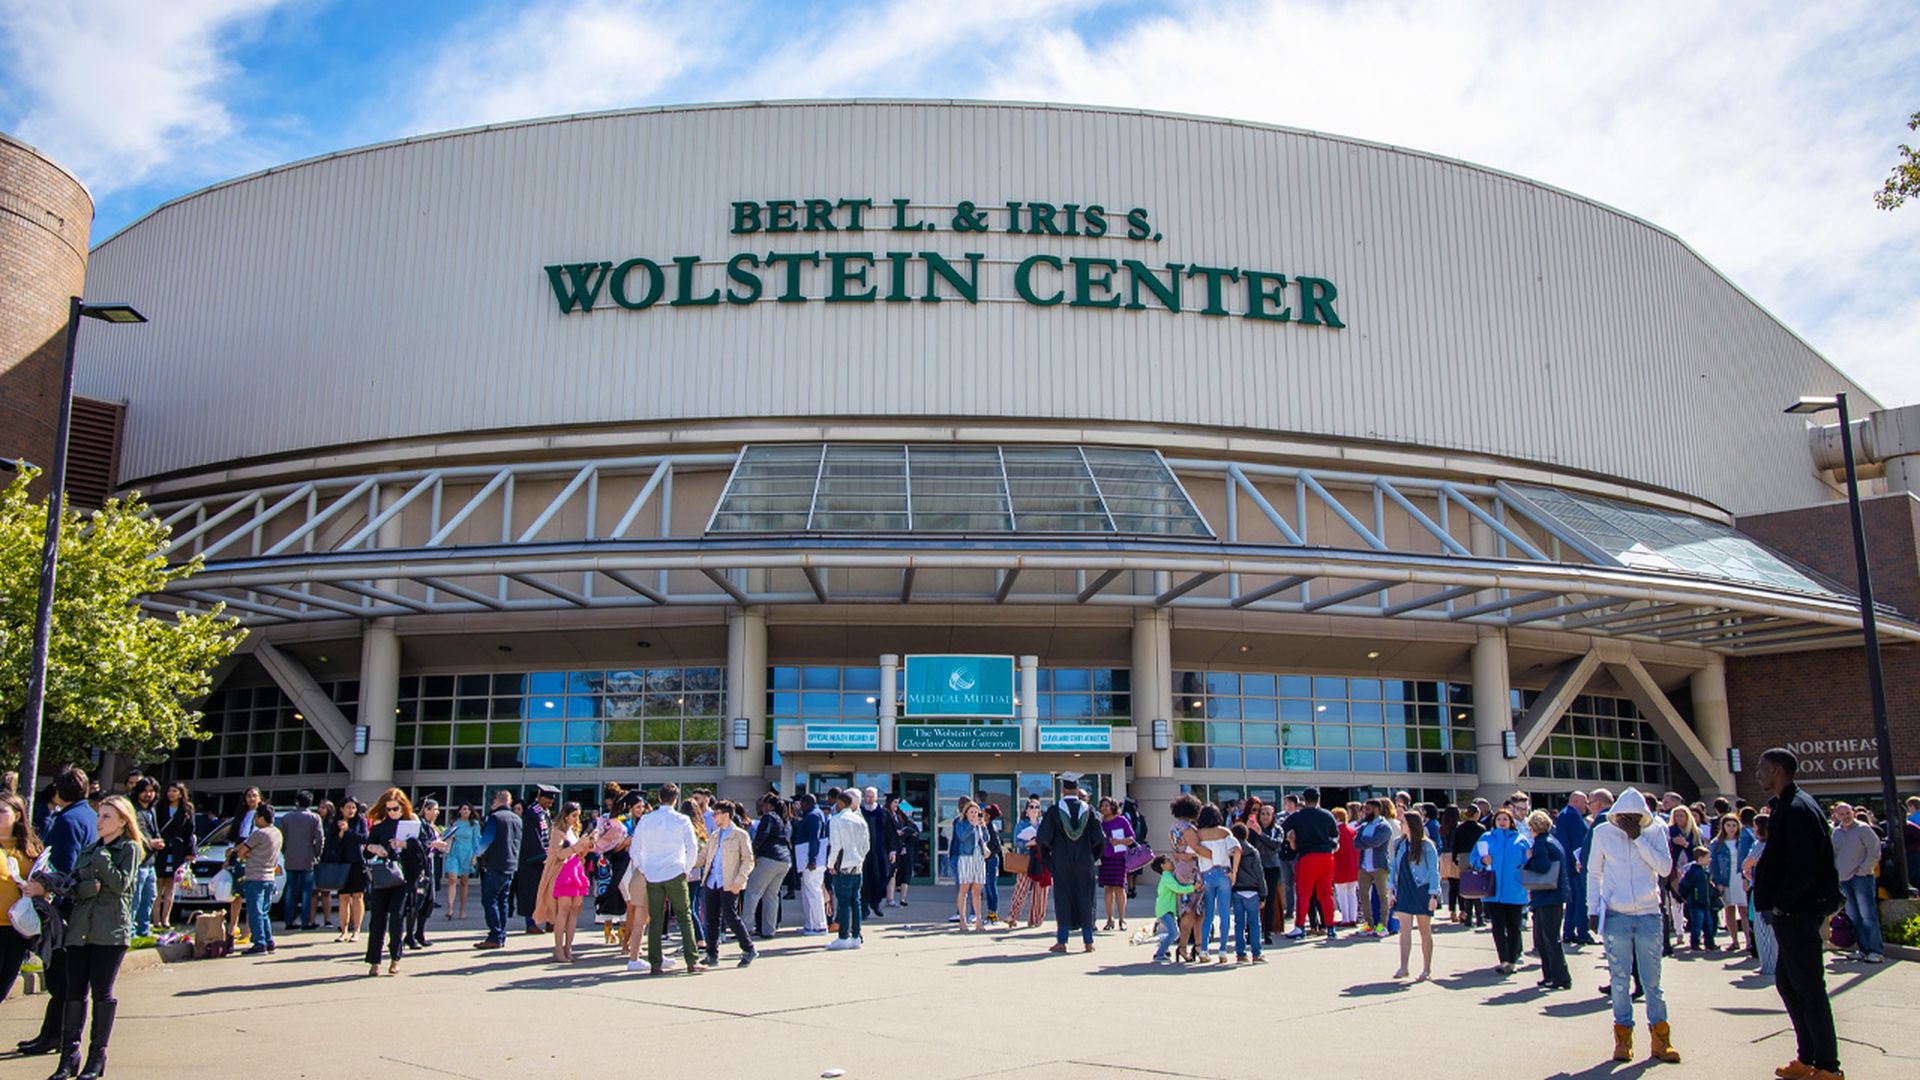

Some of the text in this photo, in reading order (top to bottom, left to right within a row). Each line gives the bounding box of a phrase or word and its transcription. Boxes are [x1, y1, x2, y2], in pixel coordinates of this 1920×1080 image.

[731, 198, 1162, 242] BERT L. & IRIS S.
[544, 250, 1346, 329] WOLSTEIN CENTER
[913, 728, 932, 737] The
[972, 728, 1004, 737] Center
[902, 739, 1016, 750] Cleveland State University
[1786, 737, 1878, 755] NORTHEAS
[1795, 756, 1881, 773] OX OFFIC
